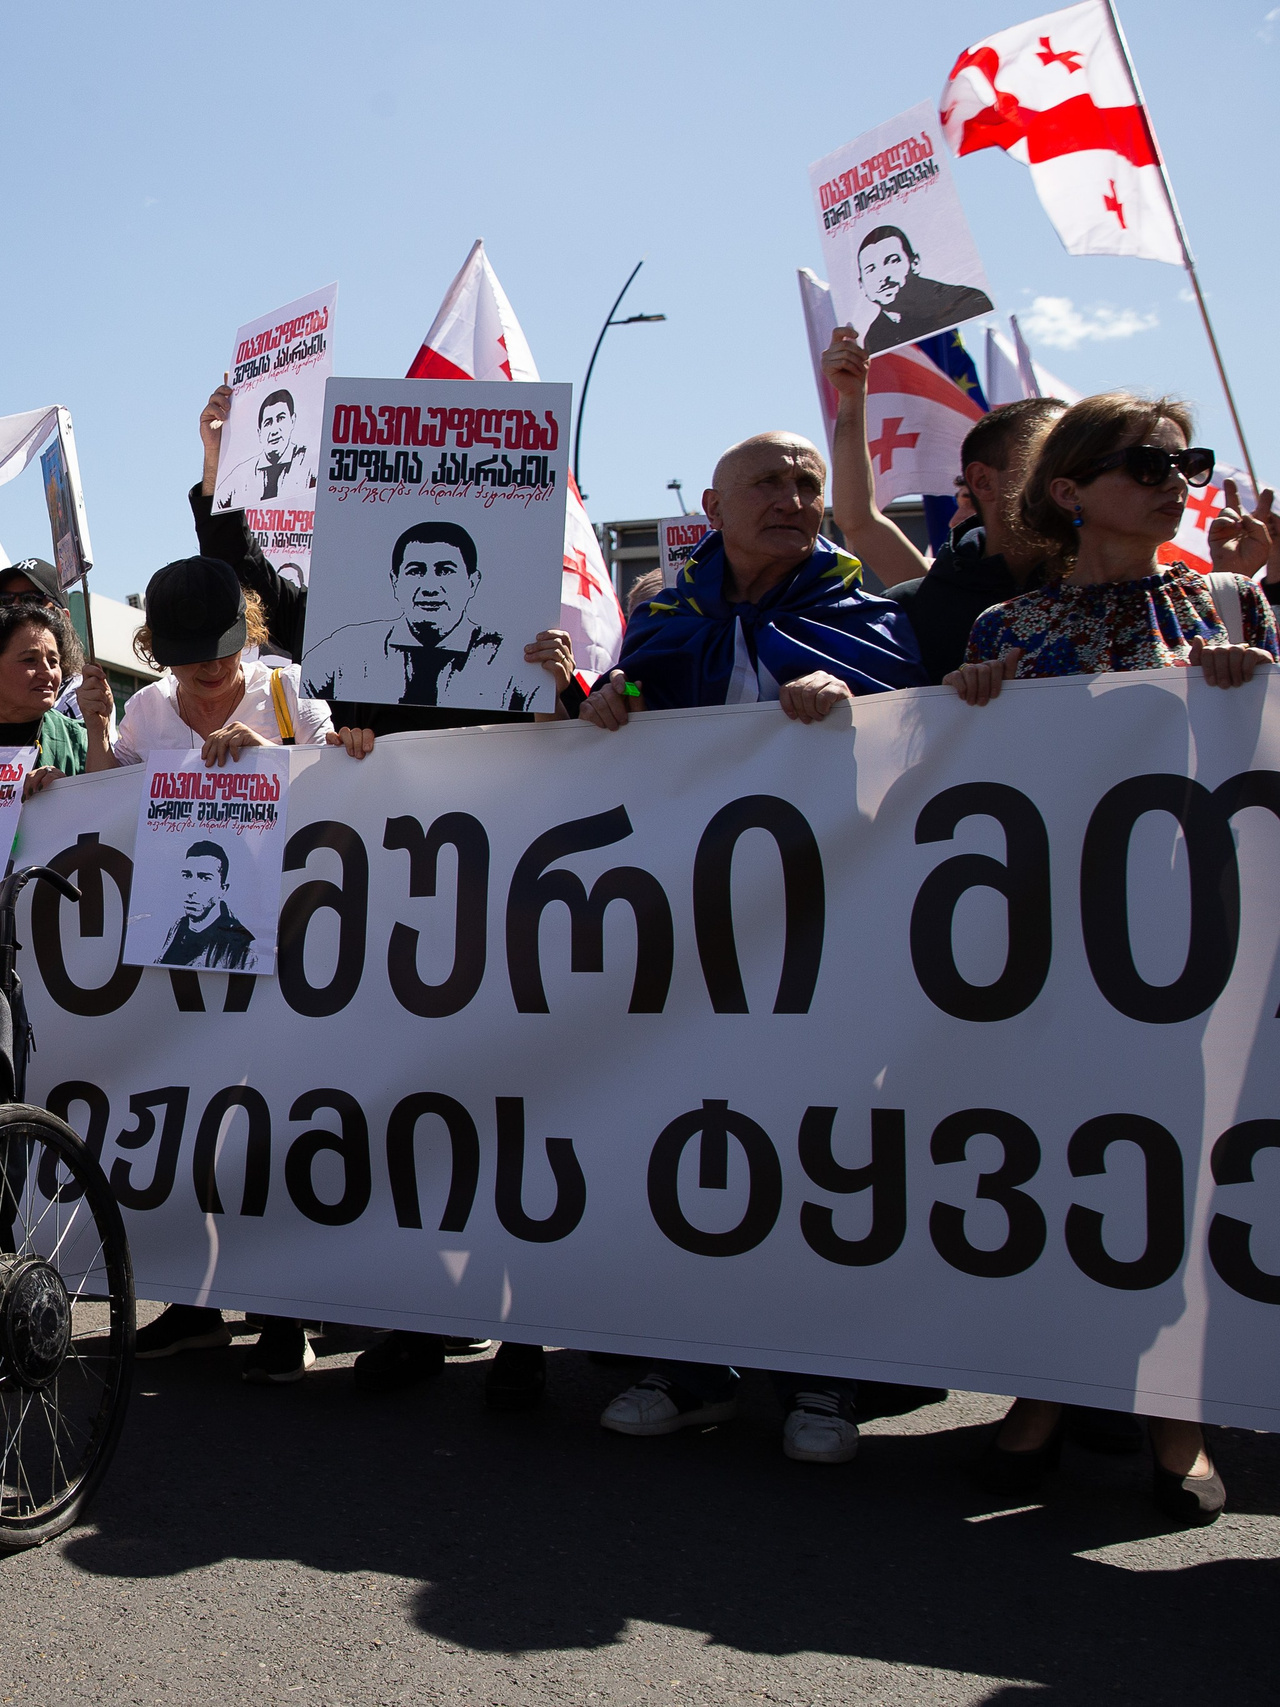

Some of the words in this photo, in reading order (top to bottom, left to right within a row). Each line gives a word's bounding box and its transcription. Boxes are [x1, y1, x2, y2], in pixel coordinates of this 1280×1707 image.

[819, 131, 934, 211] თავისუფლება
[236, 306, 328, 364] თავისუფლება
[332, 404, 559, 451] თავისუფლება
[329, 448, 423, 483] ვეფხია
[431, 452, 555, 488] კასრაძეს
[148, 800, 194, 820] არჩილ
[150, 772, 280, 801] თავისუფლება
[38, 1080, 586, 1244] ეჟიმის
